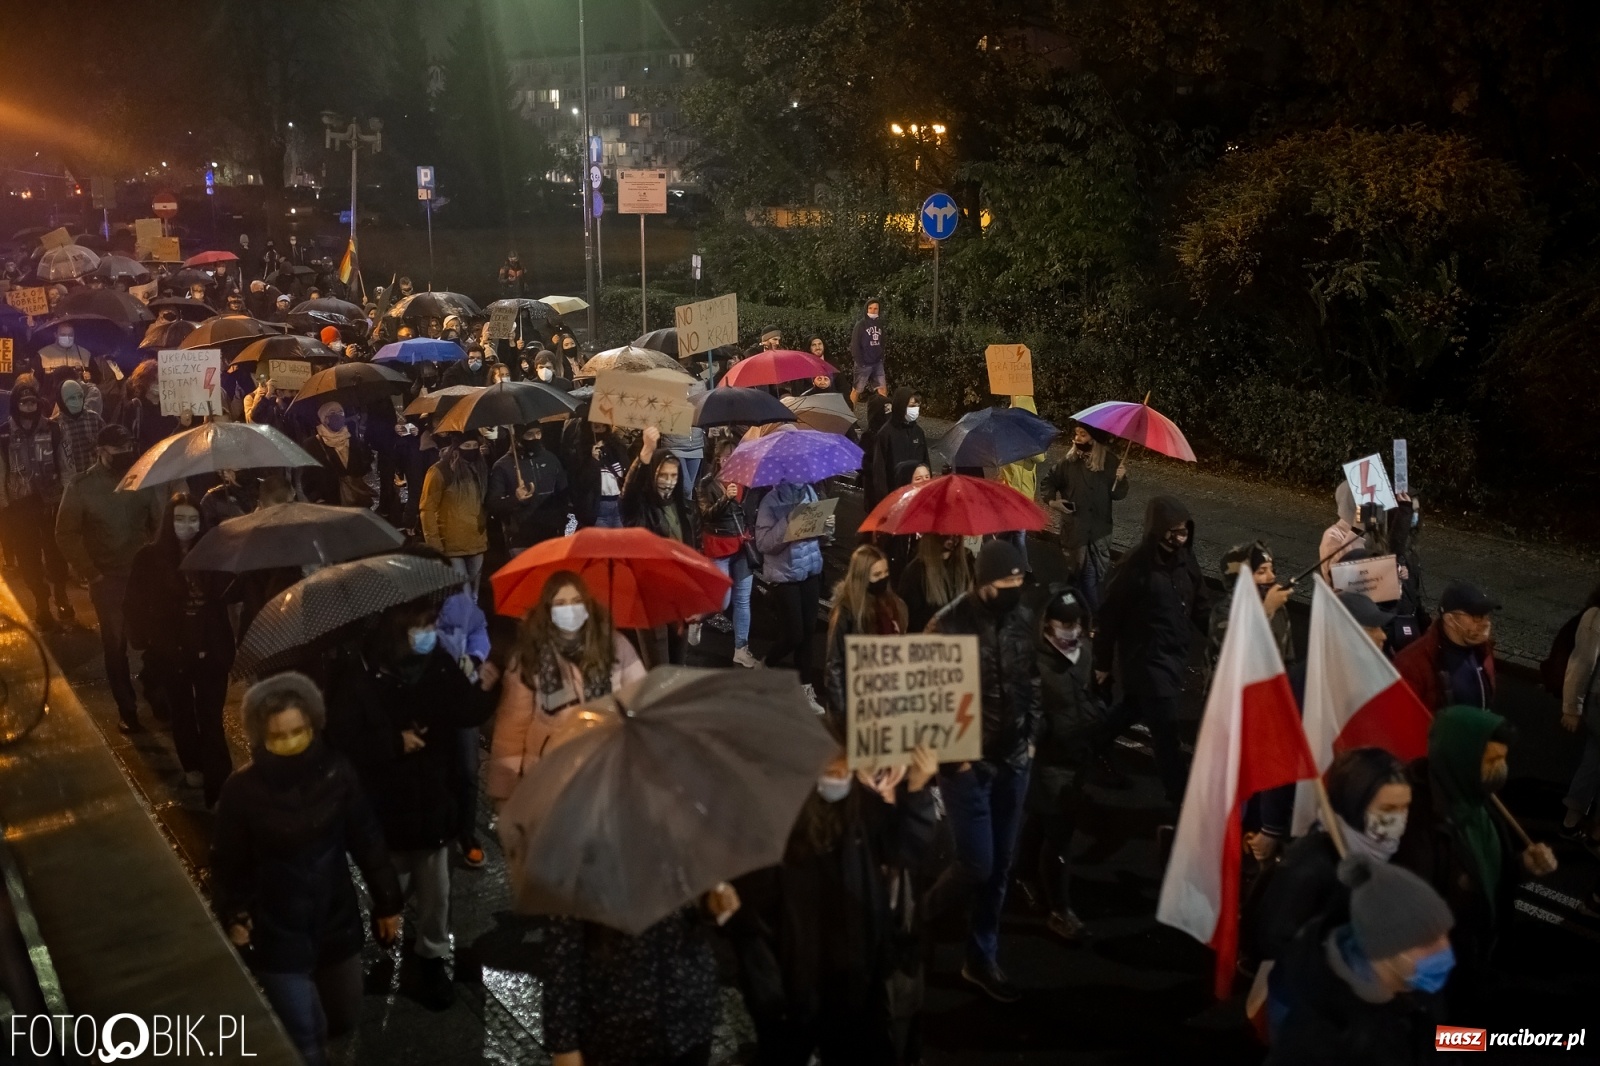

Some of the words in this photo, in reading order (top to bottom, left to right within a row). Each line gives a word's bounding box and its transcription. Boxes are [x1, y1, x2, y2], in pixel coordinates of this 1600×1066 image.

[677, 306, 693, 328] NO
[679, 331, 699, 356] NO
[708, 321, 734, 347] KRAJ
[271, 360, 286, 373] PO
[160, 380, 174, 389] TO
[176, 377, 198, 387] TAM
[850, 641, 905, 671] JAREK
[908, 642, 962, 664] ADOPTUJ
[853, 671, 899, 697] CHORE
[905, 665, 964, 690] DZIECKO
[855, 694, 926, 722] ANDRZEJ
[856, 721, 893, 757] NIE
[901, 719, 955, 753] LICZY
